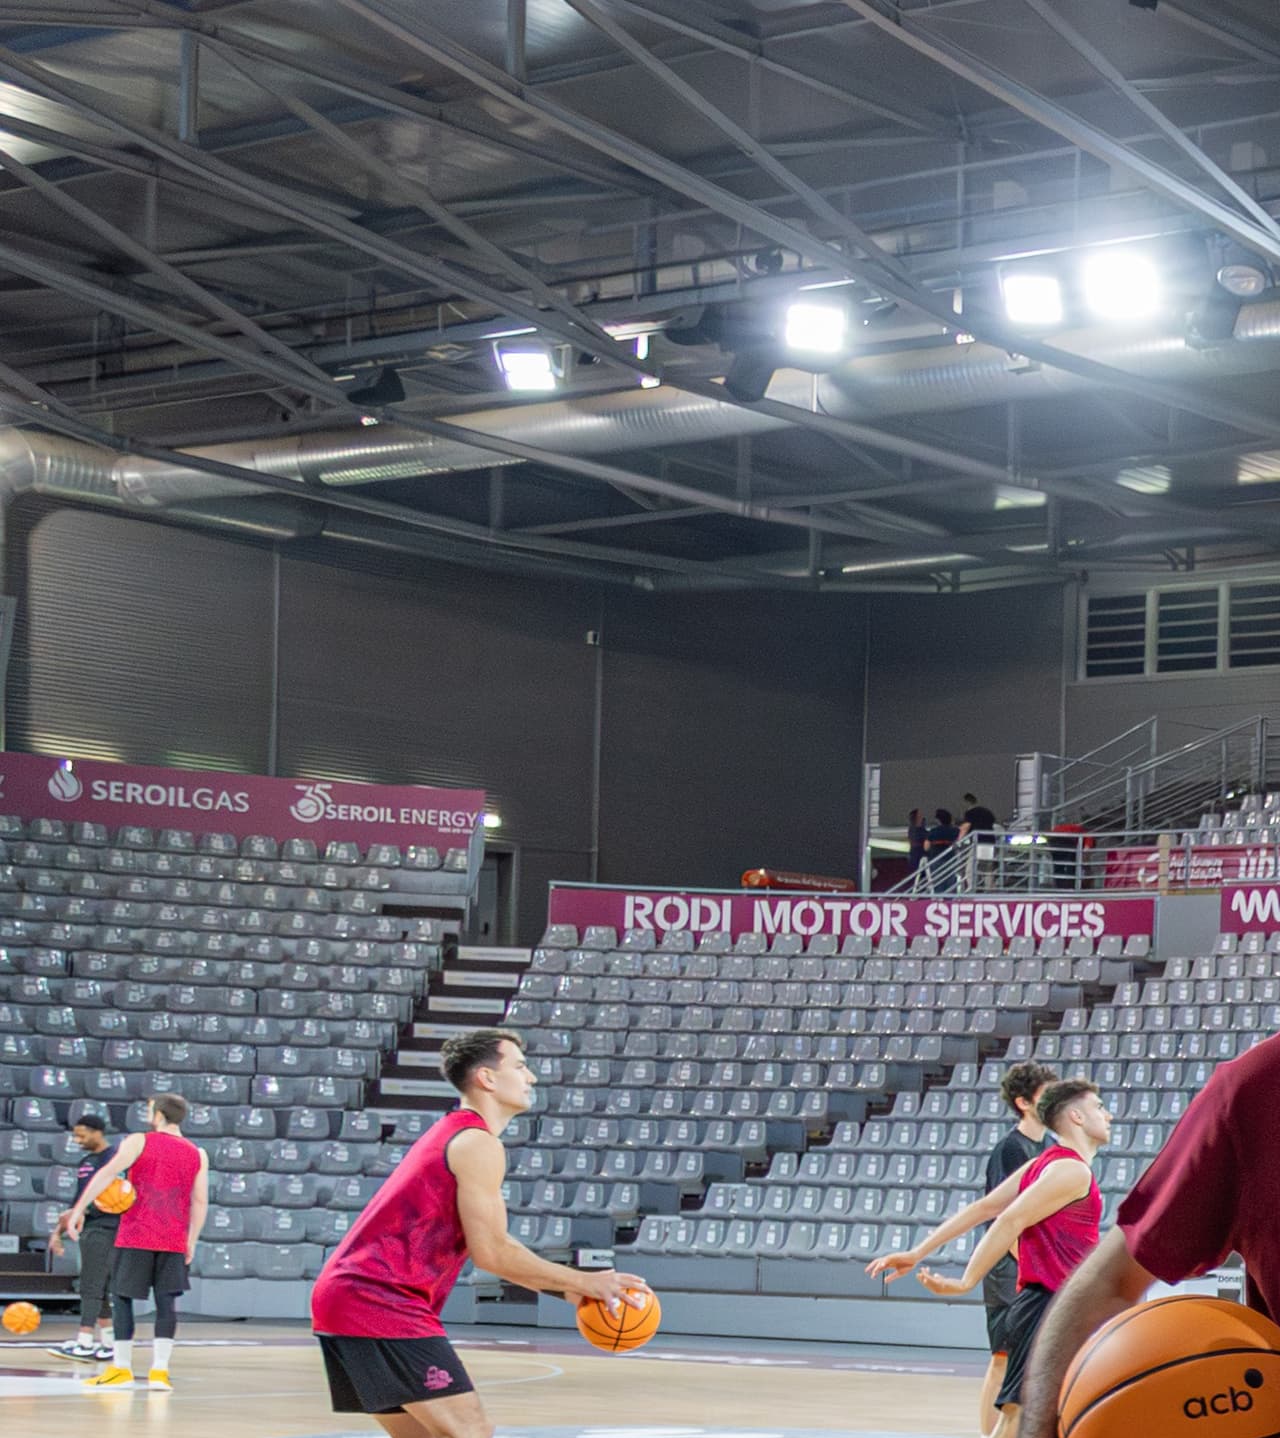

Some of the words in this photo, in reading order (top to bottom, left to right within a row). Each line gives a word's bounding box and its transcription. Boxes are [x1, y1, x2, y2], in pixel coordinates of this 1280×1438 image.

[325, 804, 396, 823] SEROIL
[400, 808, 478, 828] ENERGY
[624, 895, 732, 933] RODI
[753, 899, 908, 937] MOTOR
[925, 903, 1105, 939] SERVICES
[1183, 1387, 1254, 1419] acb
